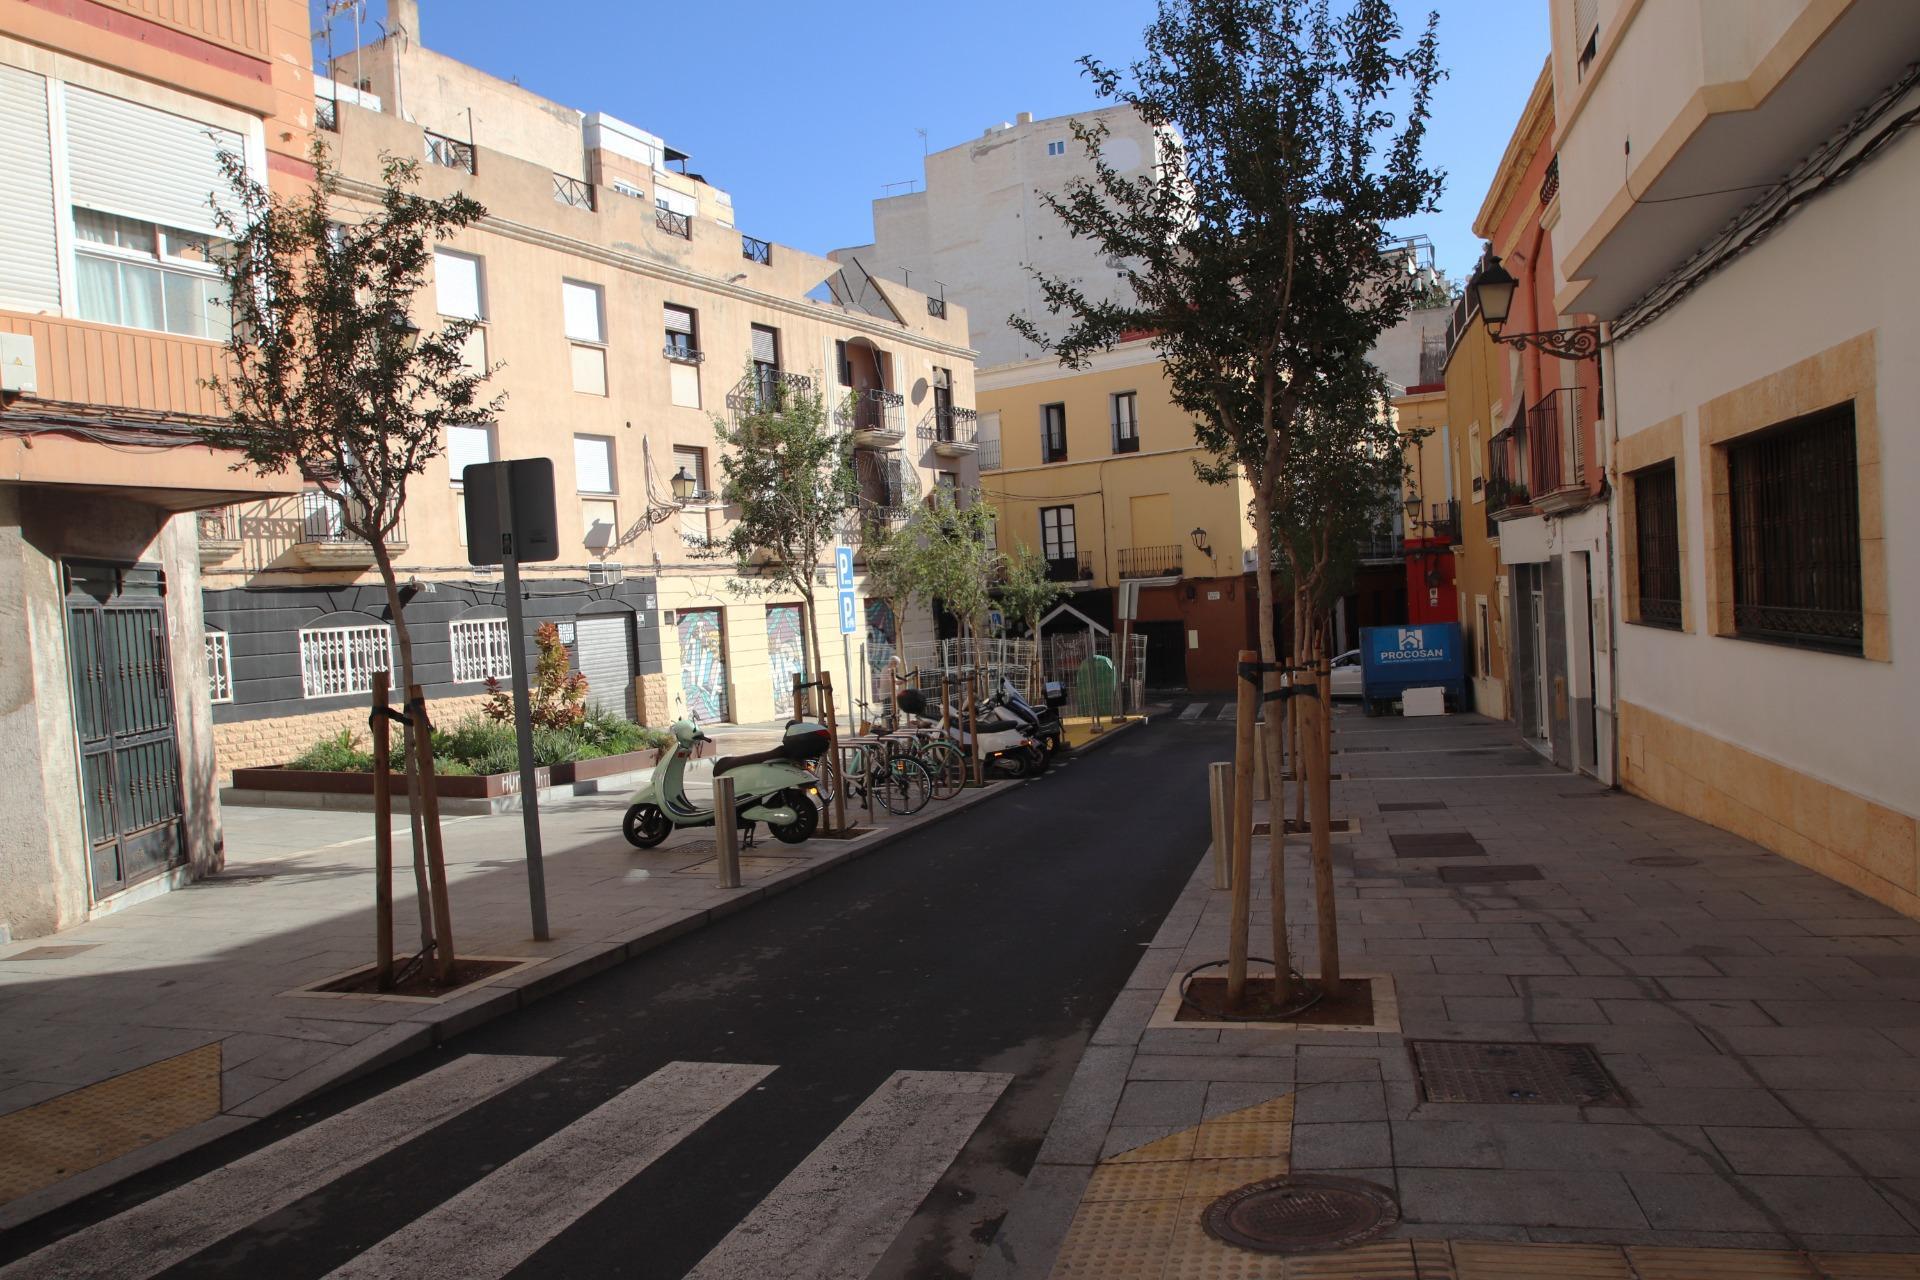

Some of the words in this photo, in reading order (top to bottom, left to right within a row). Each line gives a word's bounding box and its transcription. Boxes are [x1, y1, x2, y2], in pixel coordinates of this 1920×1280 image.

[839, 553, 848, 585] P
[843, 597, 853, 629] P
[1380, 648, 1443, 661] PROCOSAN
